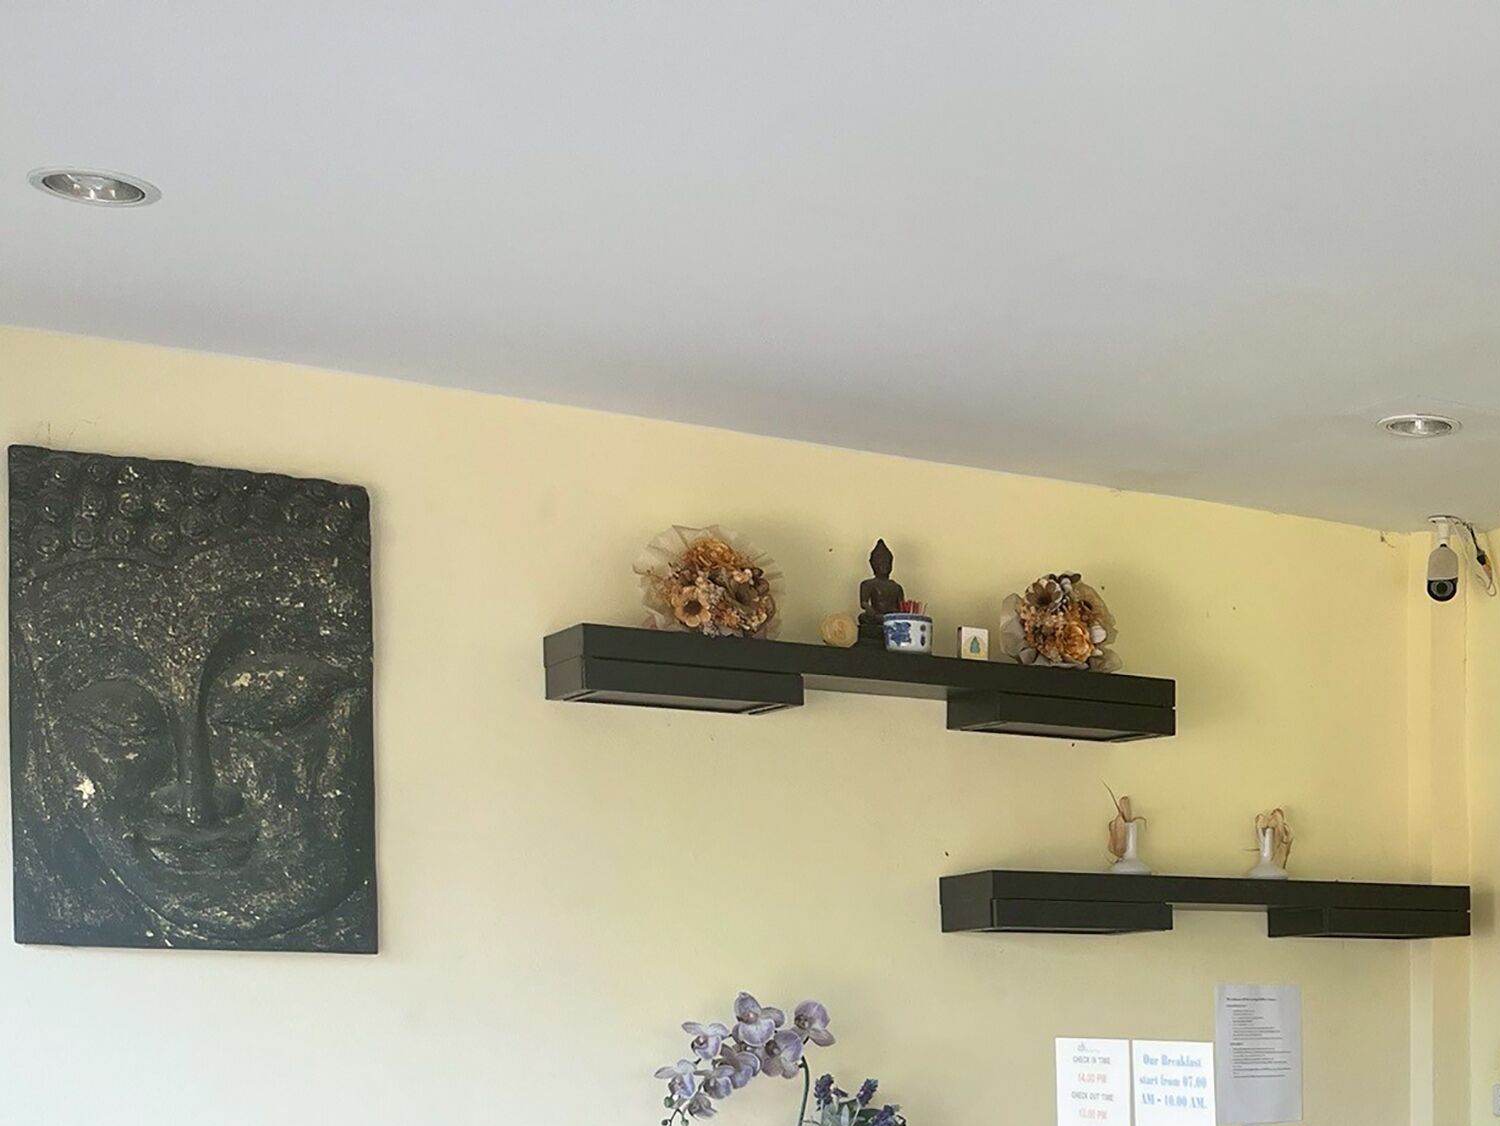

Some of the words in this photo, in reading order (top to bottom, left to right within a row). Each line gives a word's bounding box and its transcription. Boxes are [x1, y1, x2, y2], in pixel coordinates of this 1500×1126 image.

[1142, 1053, 1159, 1066] Our
[1161, 1054, 1202, 1067] Breakfast
[1139, 1075, 1159, 1085] start
[1160, 1074, 1181, 1087] from
[1142, 1093, 1155, 1105] AM
